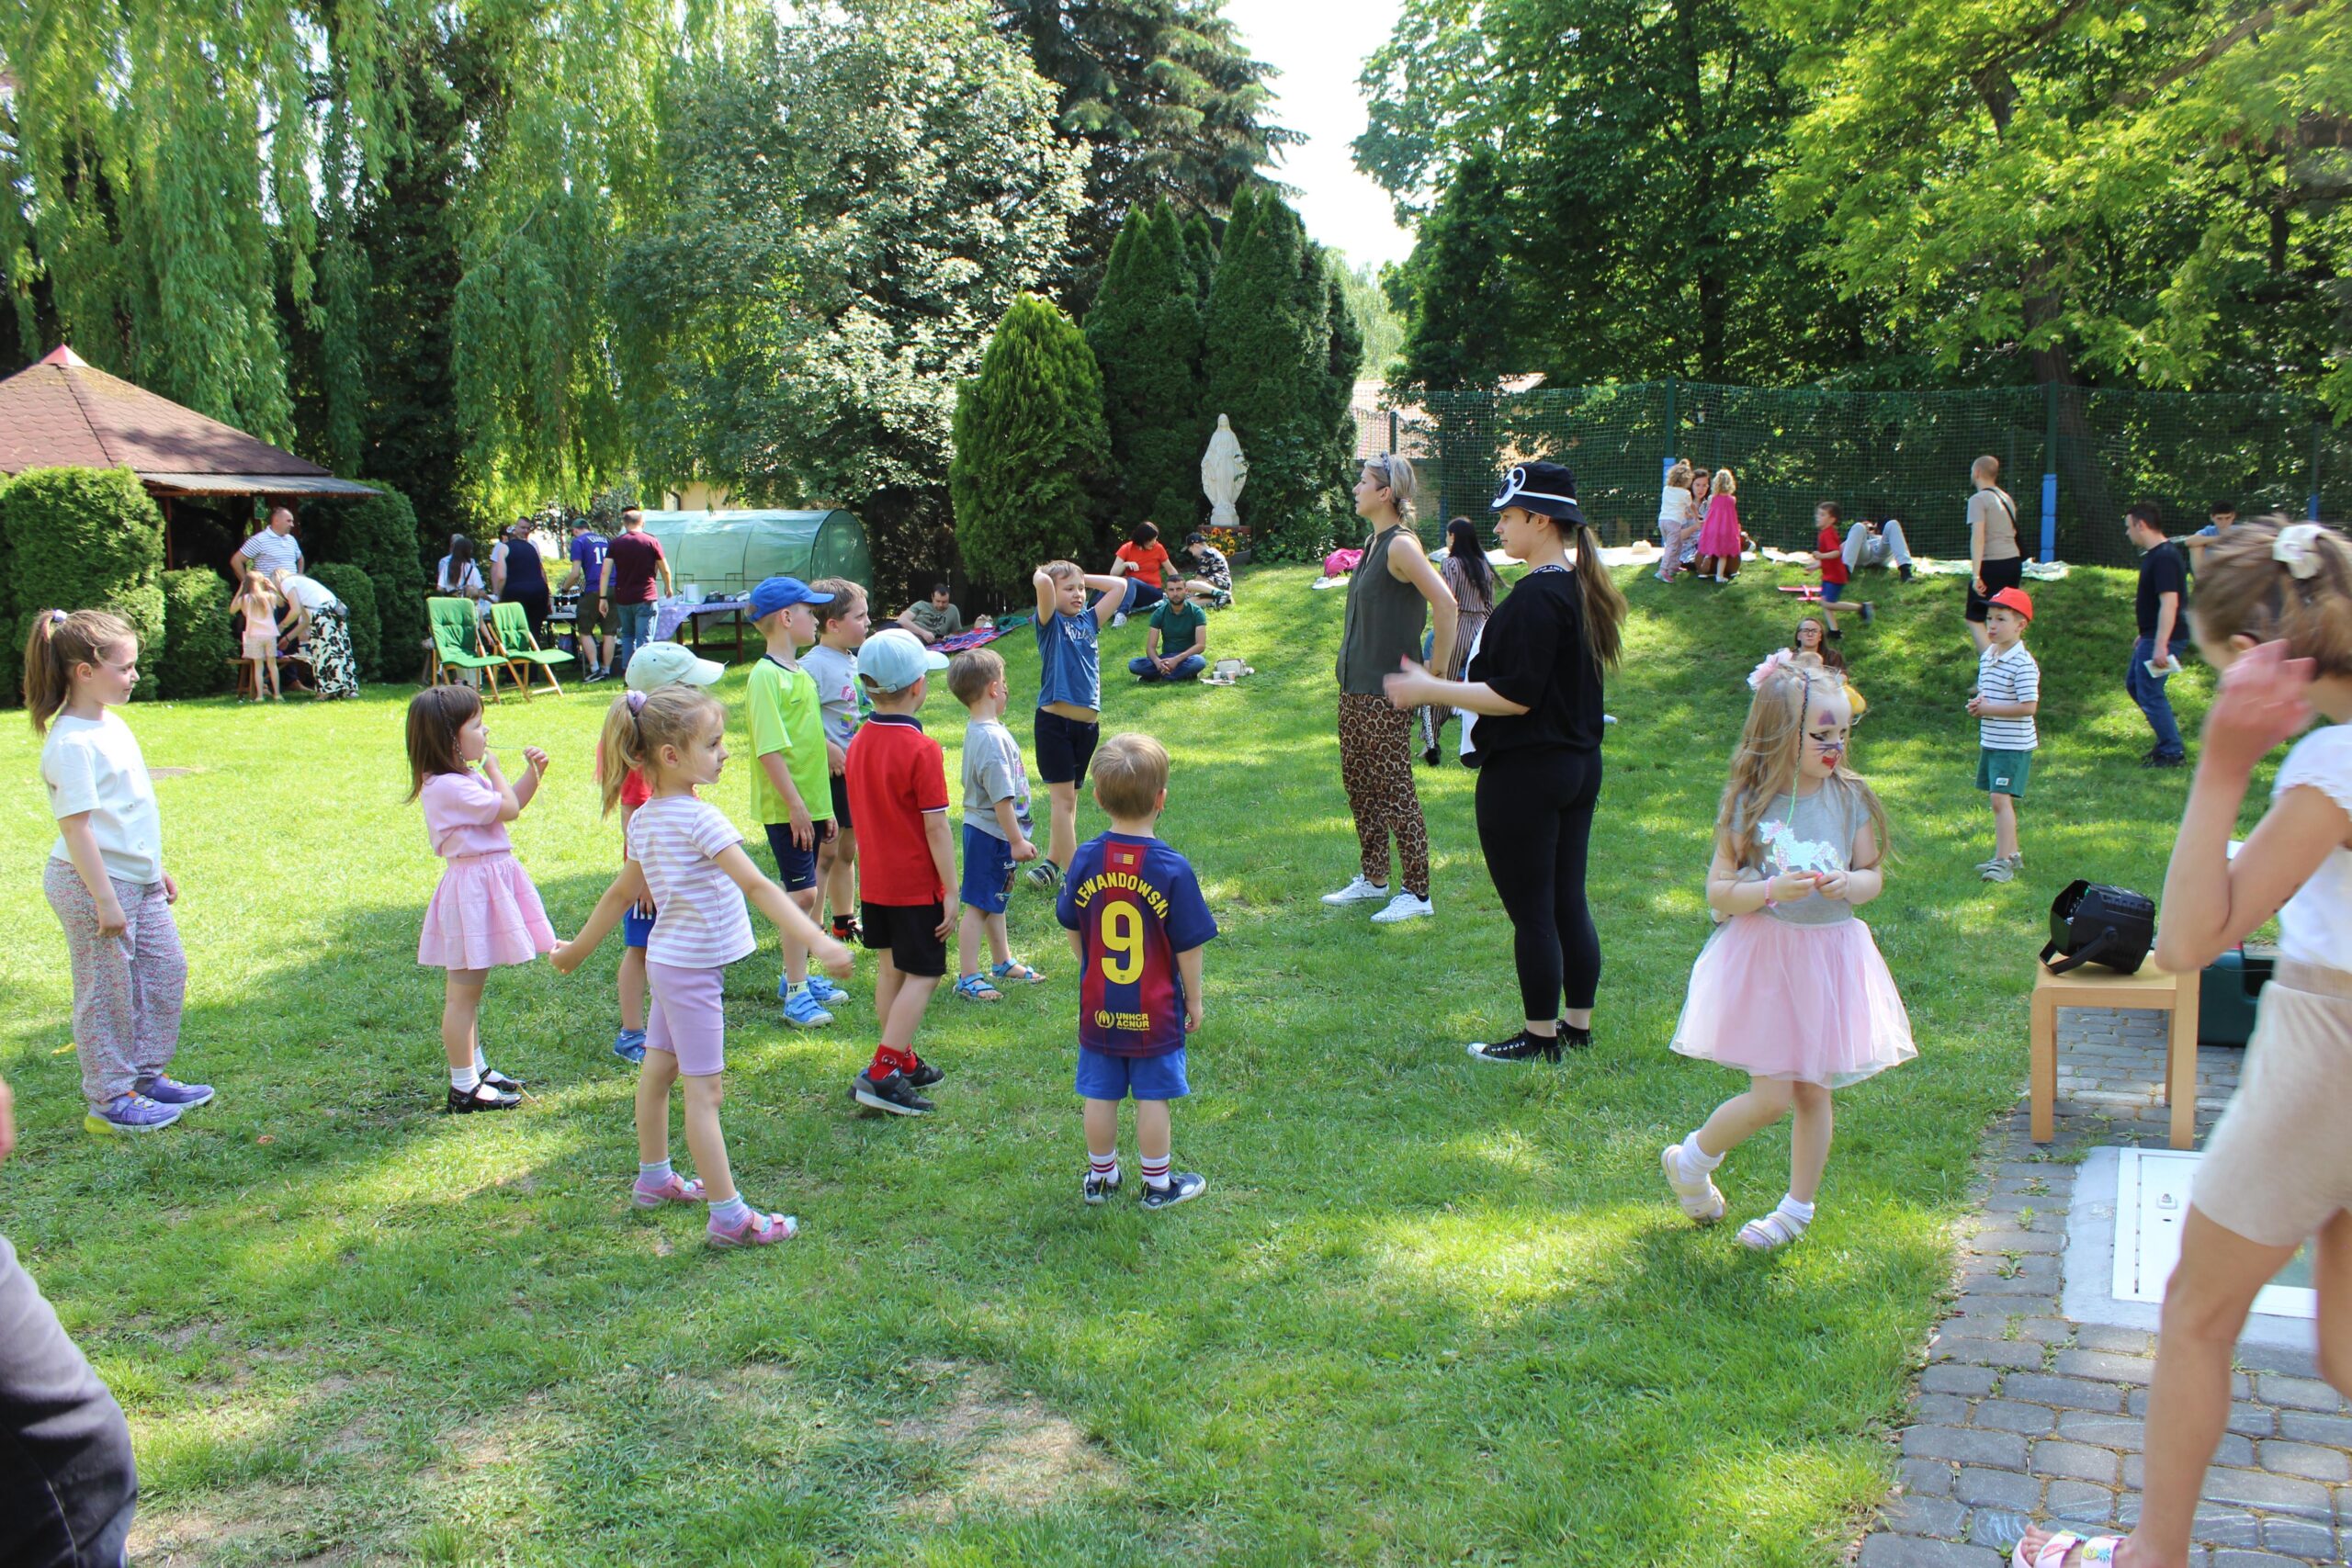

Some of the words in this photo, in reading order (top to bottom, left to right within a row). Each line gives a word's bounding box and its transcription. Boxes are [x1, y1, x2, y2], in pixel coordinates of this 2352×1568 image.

[1074, 872, 1169, 919] LEWANDOWSKI
[1101, 900, 1145, 985] 9
[1115, 1012, 1149, 1021] UNHCR
[1116, 1020, 1150, 1028] ACNUR
